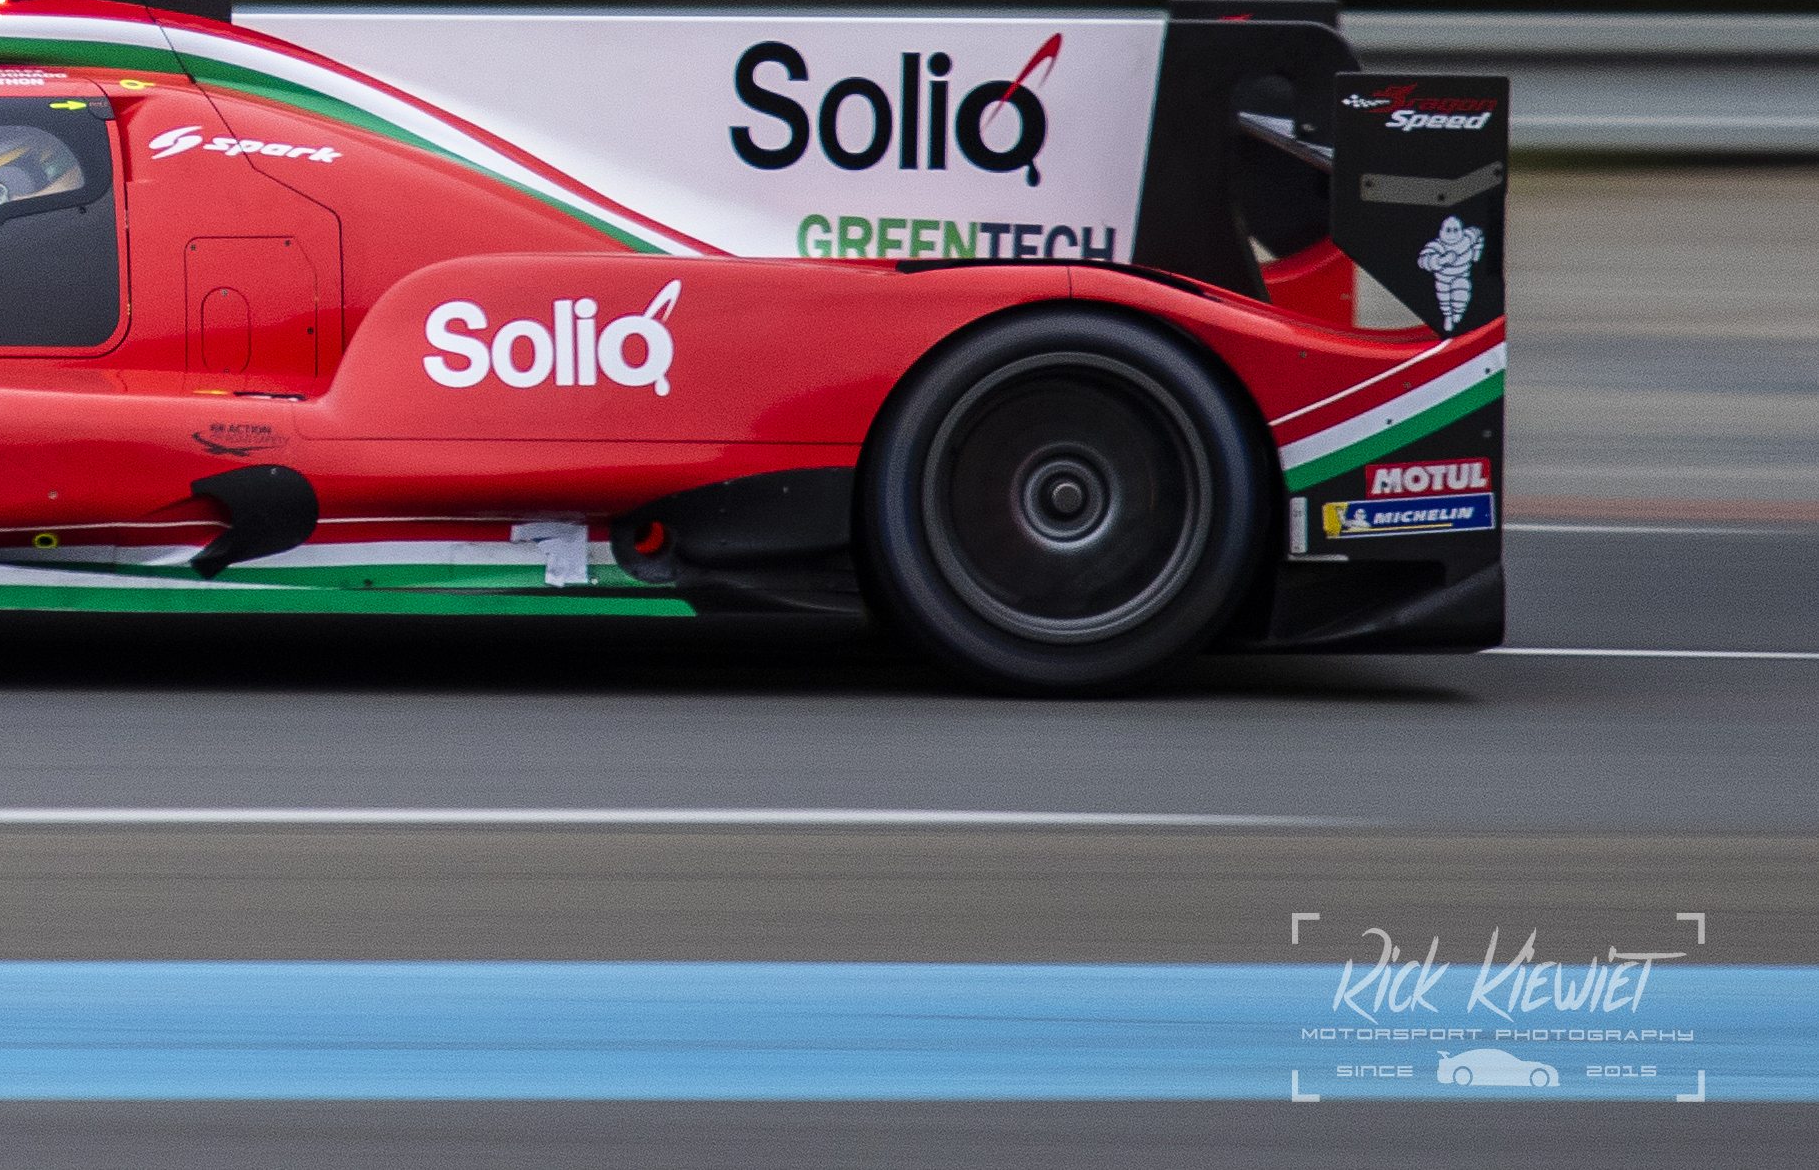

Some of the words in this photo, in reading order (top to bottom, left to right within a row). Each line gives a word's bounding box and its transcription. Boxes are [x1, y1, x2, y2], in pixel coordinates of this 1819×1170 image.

[1385, 109, 1492, 132] Speed
[203, 137, 343, 163] spark
[796, 214, 1117, 261] GREENTECH
[1371, 462, 1488, 495] MOTUL
[1373, 507, 1475, 525] MICHELIN
